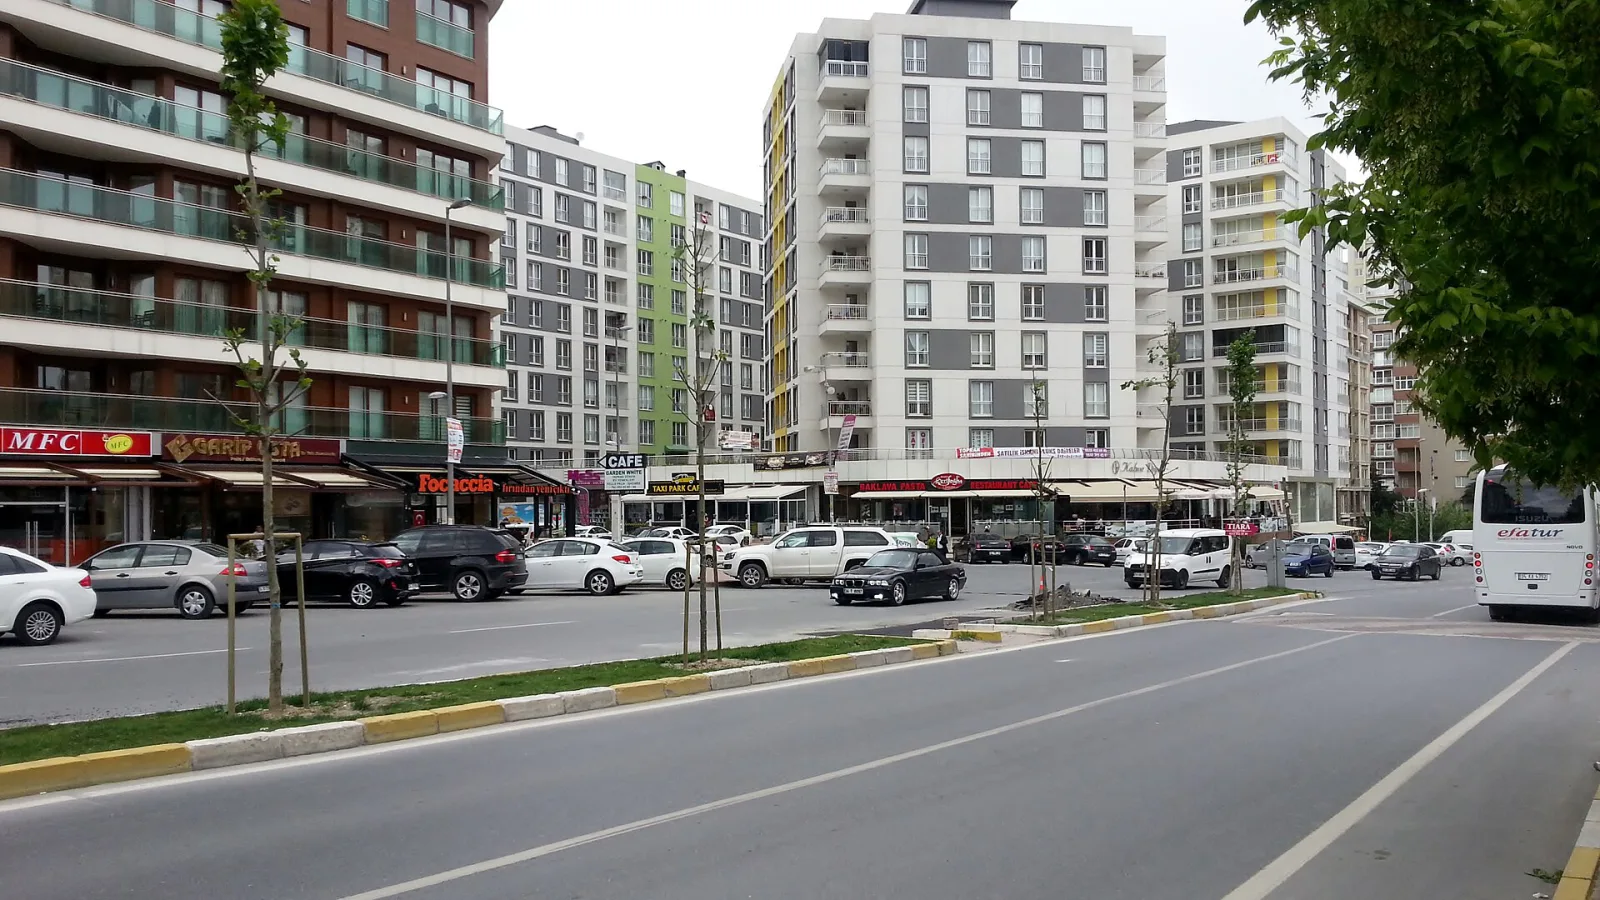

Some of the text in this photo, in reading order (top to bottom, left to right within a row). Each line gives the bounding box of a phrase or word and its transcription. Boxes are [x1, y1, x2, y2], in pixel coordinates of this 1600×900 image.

[8, 432, 79, 451] MFC
[111, 440, 128, 449] MFC
[192, 437, 252, 456] GARİP
[608, 455, 643, 468] CAFE
[418, 474, 494, 493] Focaccia
[653, 485, 668, 493] TAXI
[687, 484, 700, 492] CAF
[860, 482, 926, 491] BAKLAVA PASTA
[970, 481, 1016, 489] RESTAURANT
